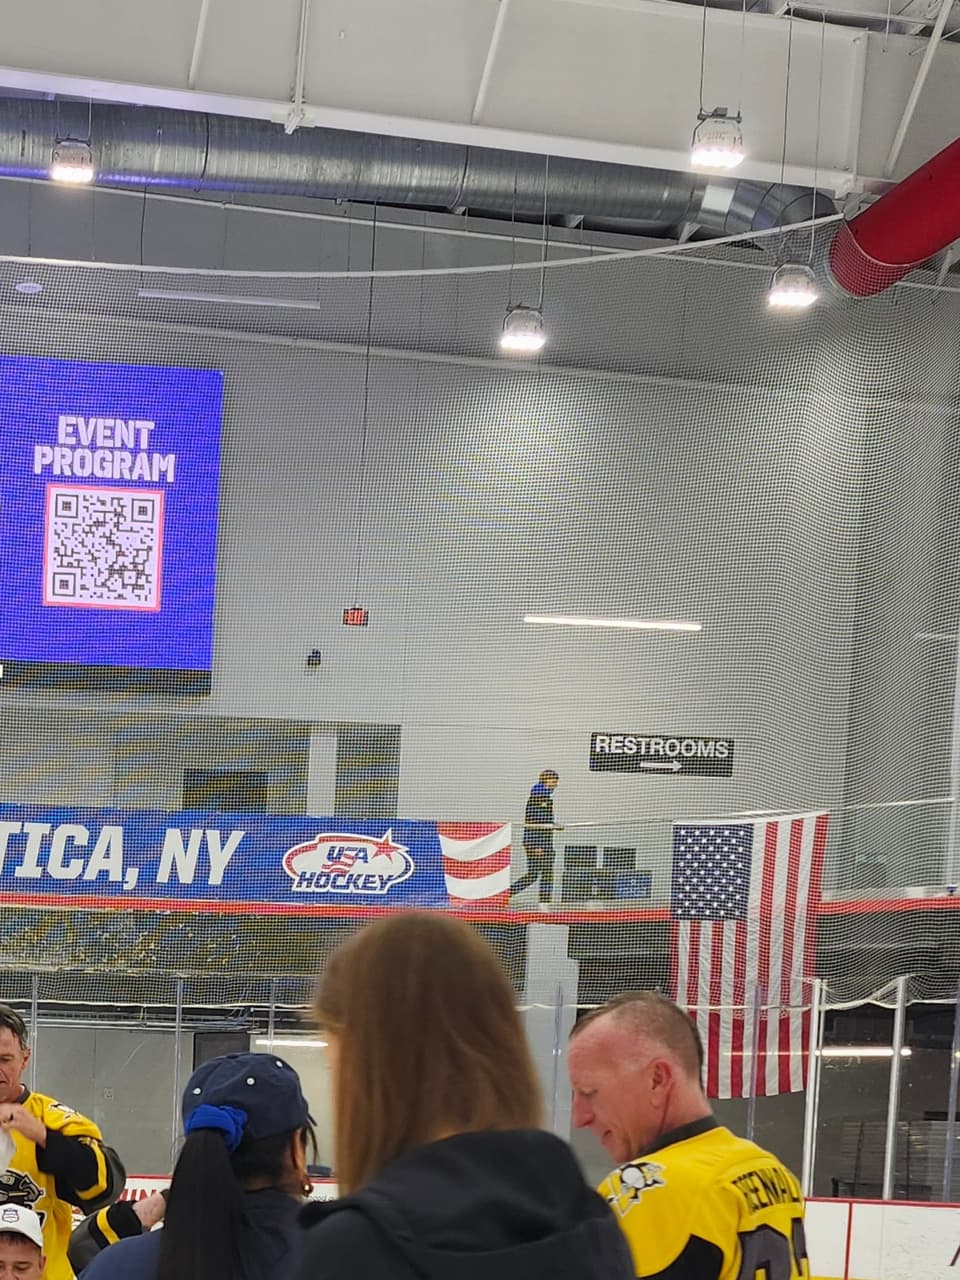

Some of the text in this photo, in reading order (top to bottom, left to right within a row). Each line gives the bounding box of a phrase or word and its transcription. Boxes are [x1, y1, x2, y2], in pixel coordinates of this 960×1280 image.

[58, 415, 155, 450] EVENT
[33, 445, 176, 483] PROGRAM
[595, 735, 730, 760] RESTROOMS
[157, 828, 246, 886] NY
[326, 845, 370, 865] USA
[297, 870, 395, 892] HOCKEY
